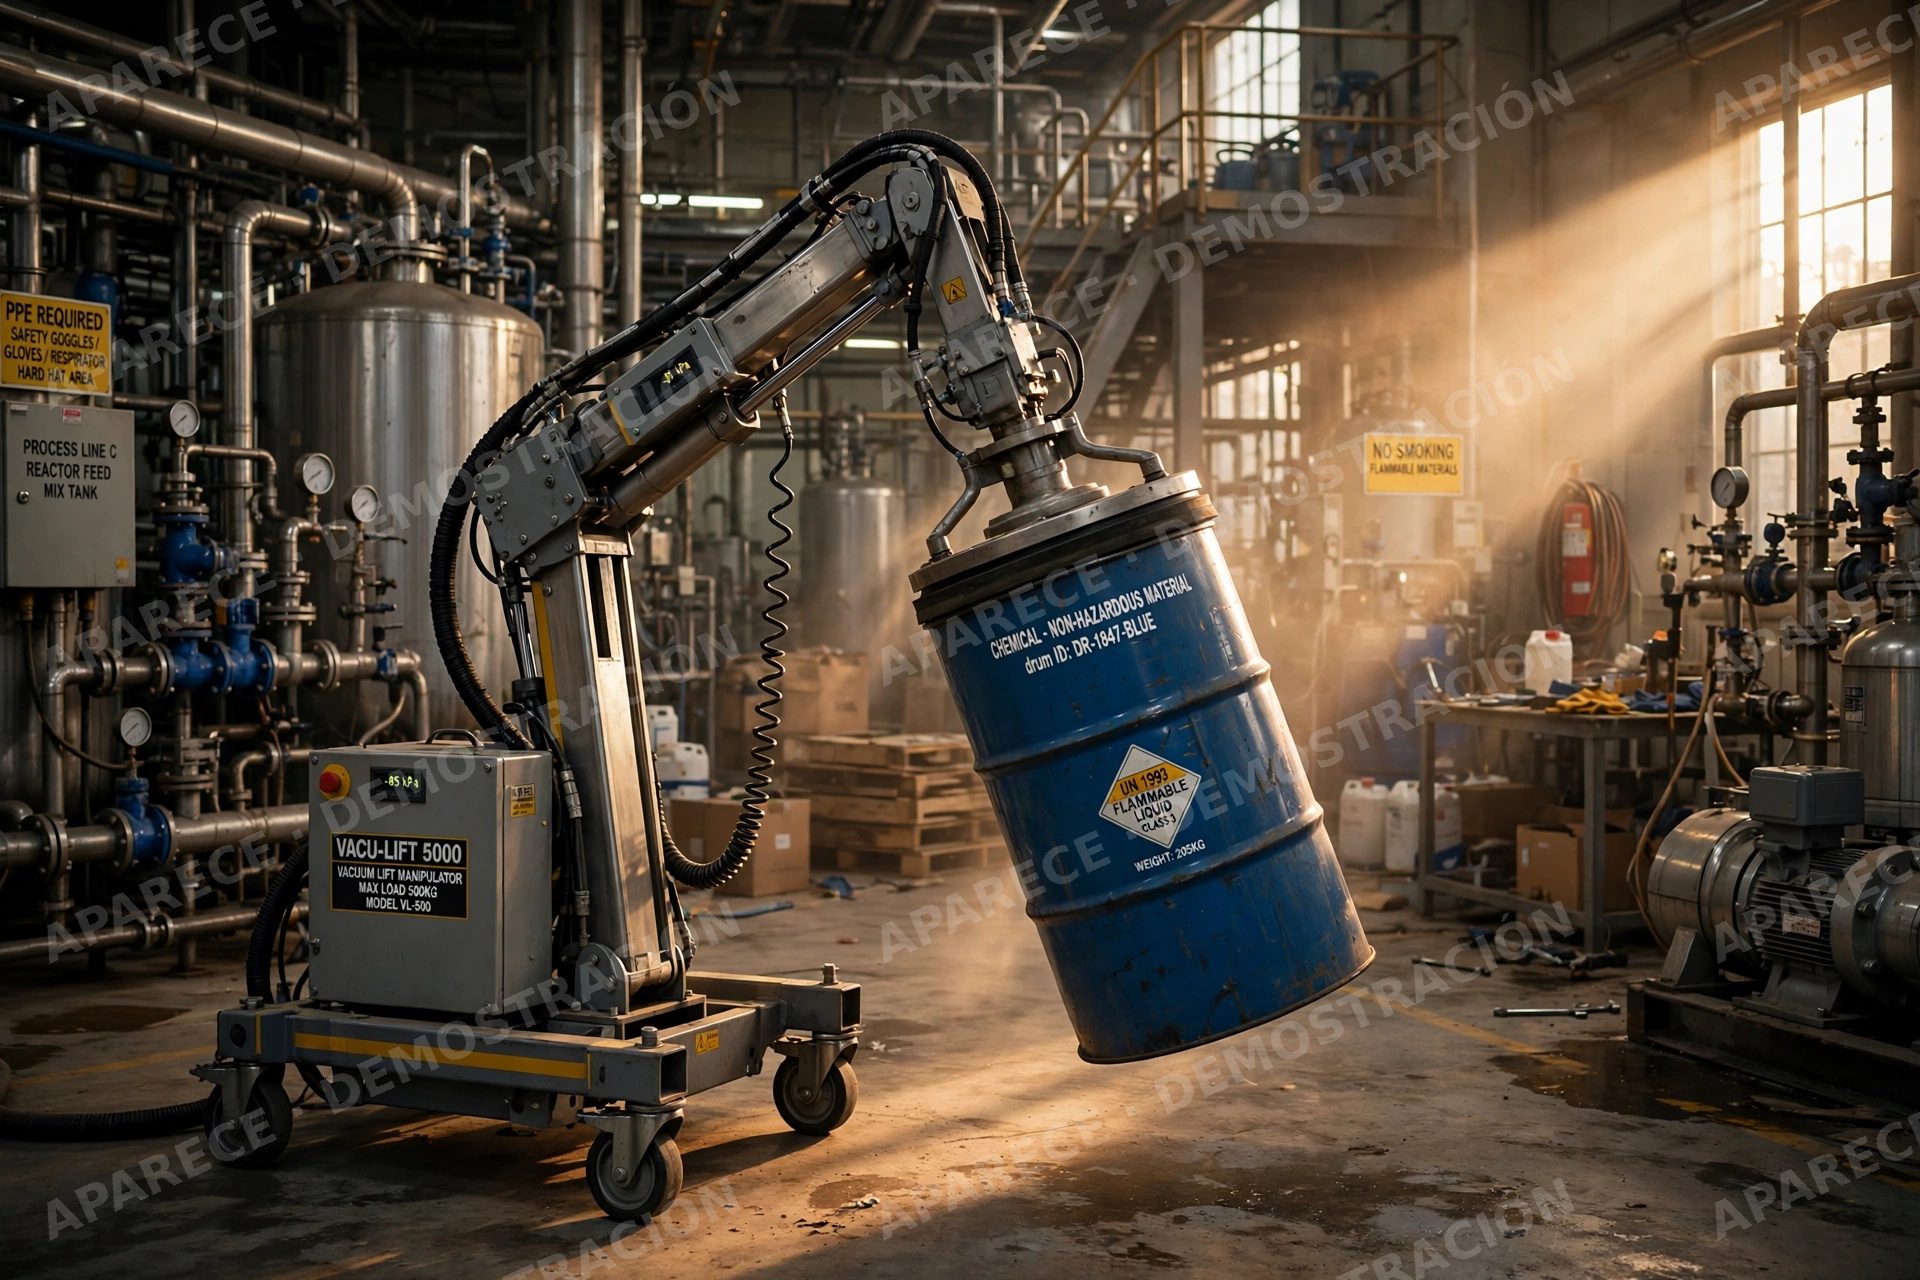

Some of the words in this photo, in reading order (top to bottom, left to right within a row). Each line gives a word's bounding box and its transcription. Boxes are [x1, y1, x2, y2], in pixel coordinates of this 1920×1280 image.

[6, 301, 32, 323] PPE
[37, 305, 103, 331] REQUIRED
[11, 326, 48, 344] SAFETY
[51, 331, 94, 350] GOGGLES
[4, 345, 42, 362] GLOVES
[51, 350, 106, 369] RESPIRATOR
[18, 365, 44, 380] HARD
[48, 368, 65, 382] HAT
[69, 371, 94, 385] AREA
[24, 439, 78, 457] PROCESS
[82, 442, 106, 459] LINE
[110, 444, 117, 459] C
[1373, 442, 1392, 459] NO
[1397, 443, 1454, 460] SMOKING
[26, 461, 80, 479] REACTOR
[84, 465, 111, 480] FEED
[1417, 463, 1458, 475] MATERIALS
[44, 483, 64, 499] MIX
[69, 484, 98, 500] TANK
[990, 627, 1043, 659] CHEMICAL
[1048, 590, 1144, 639] NON-HAZARDOUS
[1142, 573, 1193, 605] MATERIAL
[1025, 652, 1054, 675] drum
[1053, 644, 1072, 664] ID:
[1071, 612, 1157, 657] DR-1847-BLUE
[1120, 778, 1138, 796] UN
[1141, 768, 1169, 788] 1993
[1113, 778, 1189, 815] FLAMMABLE
[1133, 800, 1172, 822] LIQUID
[1142, 816, 1170, 832] CLASS
[1170, 813, 1177, 823] 3
[336, 837, 418, 861] VACU-LIFT
[422, 842, 462, 864] 5000
[1133, 851, 1174, 872] WEIGHT:
[1175, 839, 1206, 860] 205KG
[337, 865, 375, 879] VACUUM
[377, 868, 396, 880] LIFT
[398, 869, 463, 885] MANIPULATOR
[359, 881, 378, 894] MAX
[381, 883, 406, 896] LOAD
[408, 885, 438, 898] 500KG
[366, 897, 398, 910] MODEL
[400, 898, 431, 912] VL-500
